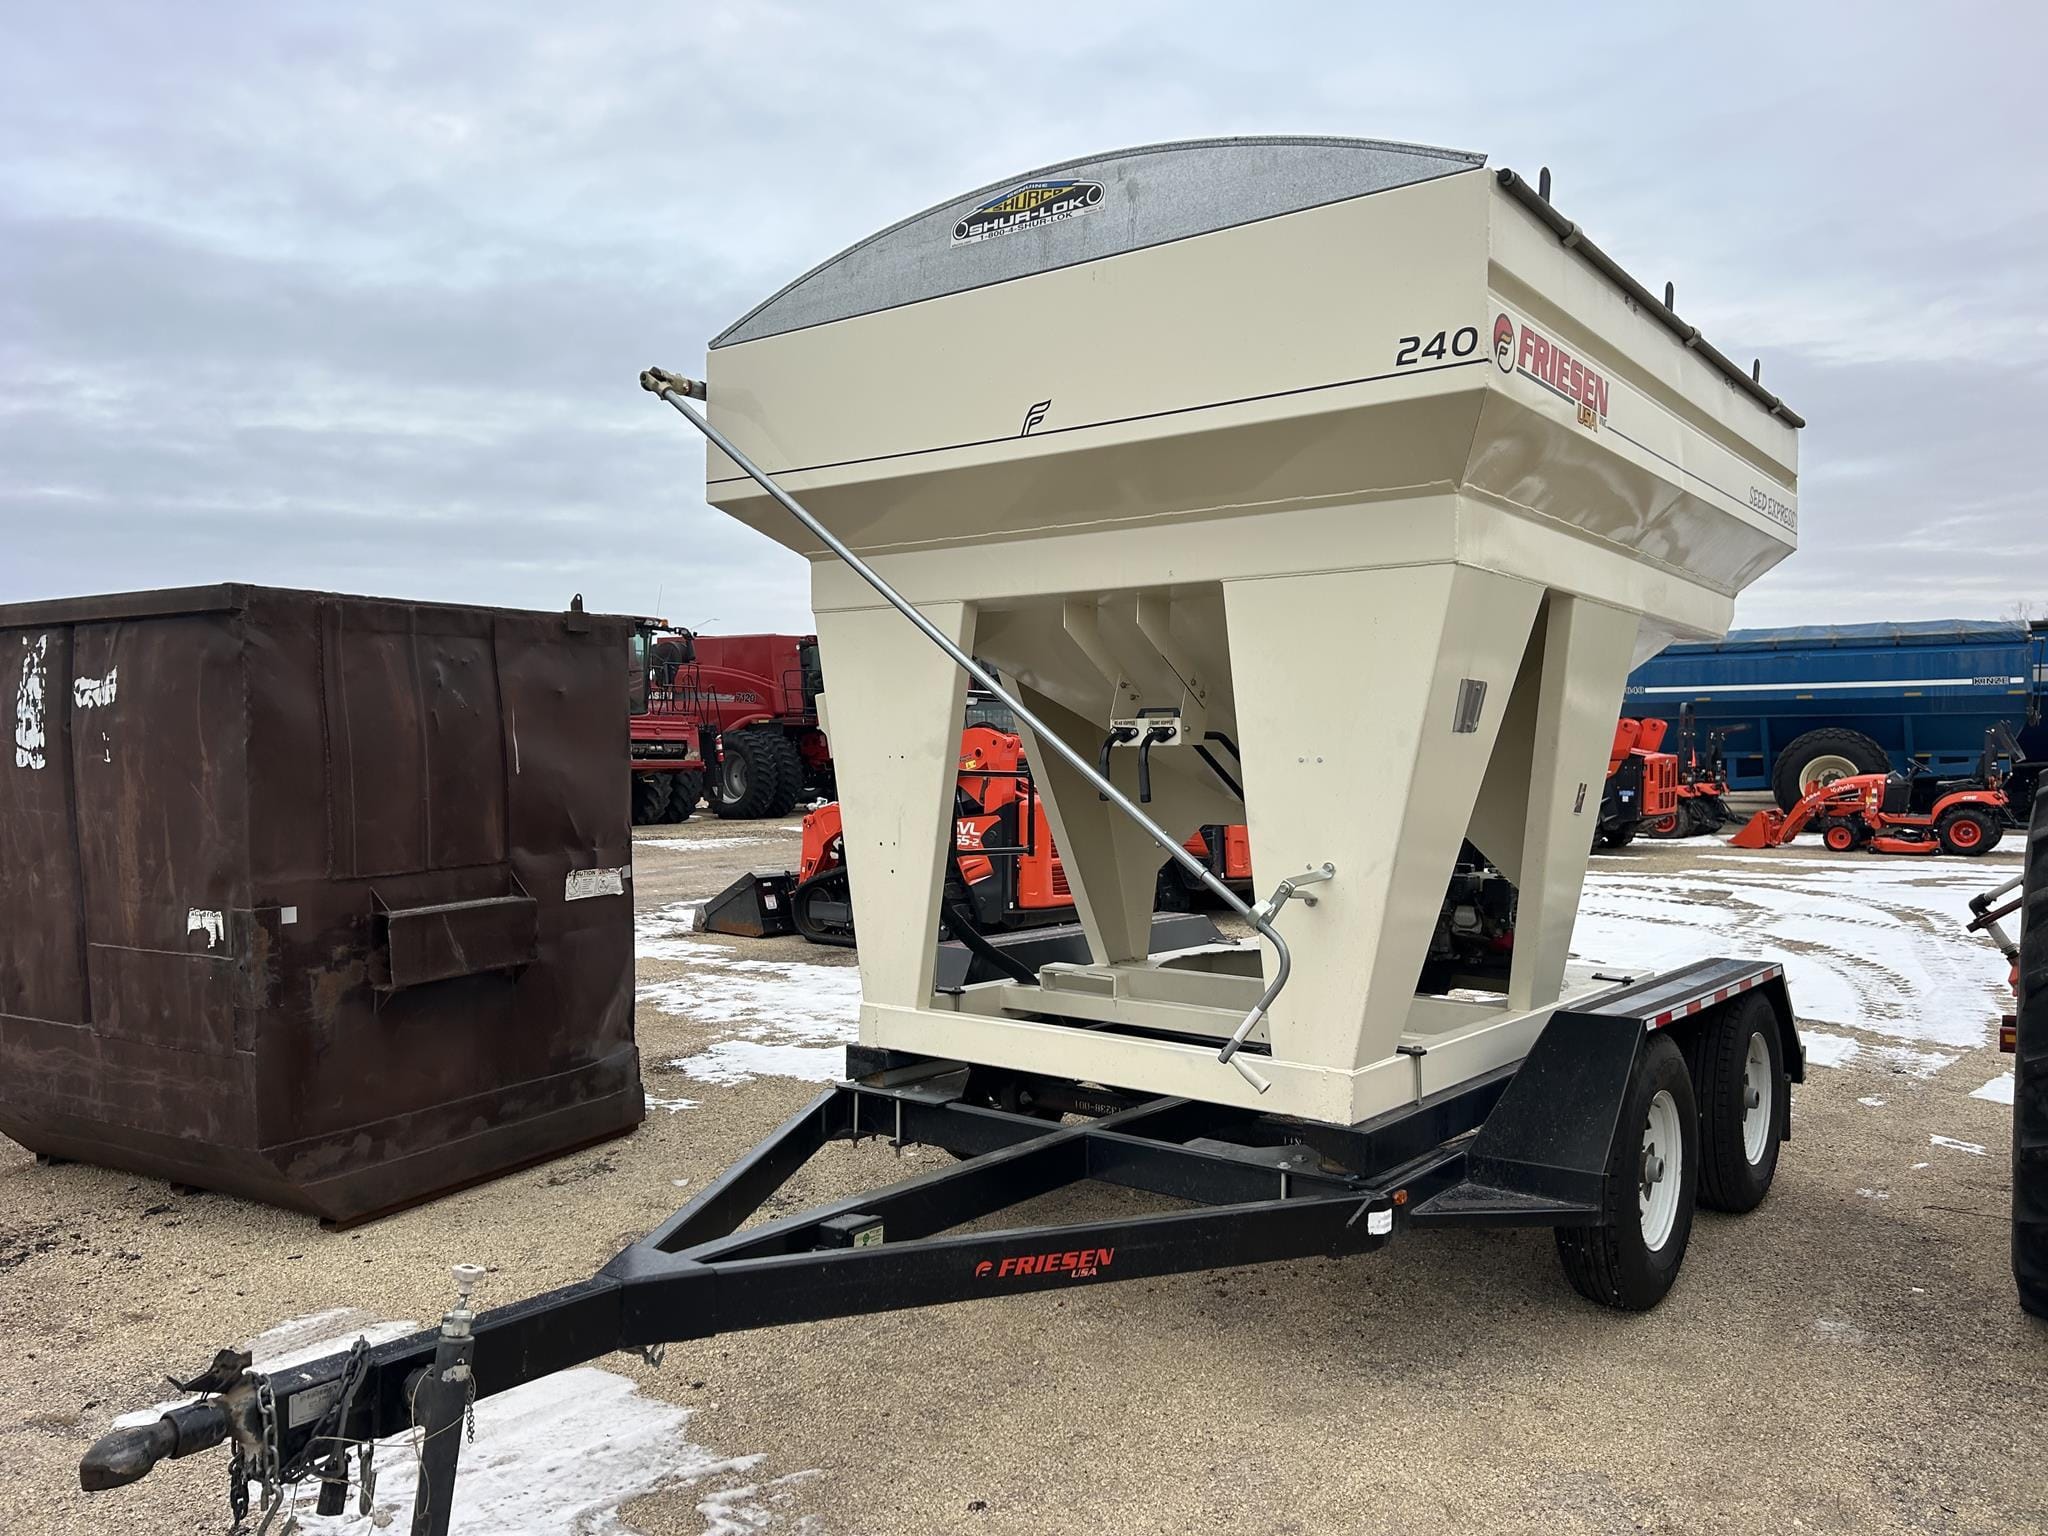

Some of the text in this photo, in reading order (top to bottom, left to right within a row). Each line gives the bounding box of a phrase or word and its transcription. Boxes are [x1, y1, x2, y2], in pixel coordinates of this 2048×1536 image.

[992, 188, 1064, 212] SHURCO
[1007, 183, 1048, 198] GENUINE
[969, 195, 1085, 236] SHUR-LOK
[980, 212, 1073, 241] 1-800-4-SHUR-LOK
[1395, 326, 1479, 366] 240
[1517, 324, 1609, 417] FRIESEN
[1576, 403, 1598, 433] USA
[1749, 486, 1797, 528] SEED EXPRESS
[1973, 676, 2009, 686] KINZE
[998, 1247, 1115, 1278] FRIESEN
[1071, 1267, 1097, 1278] USA
